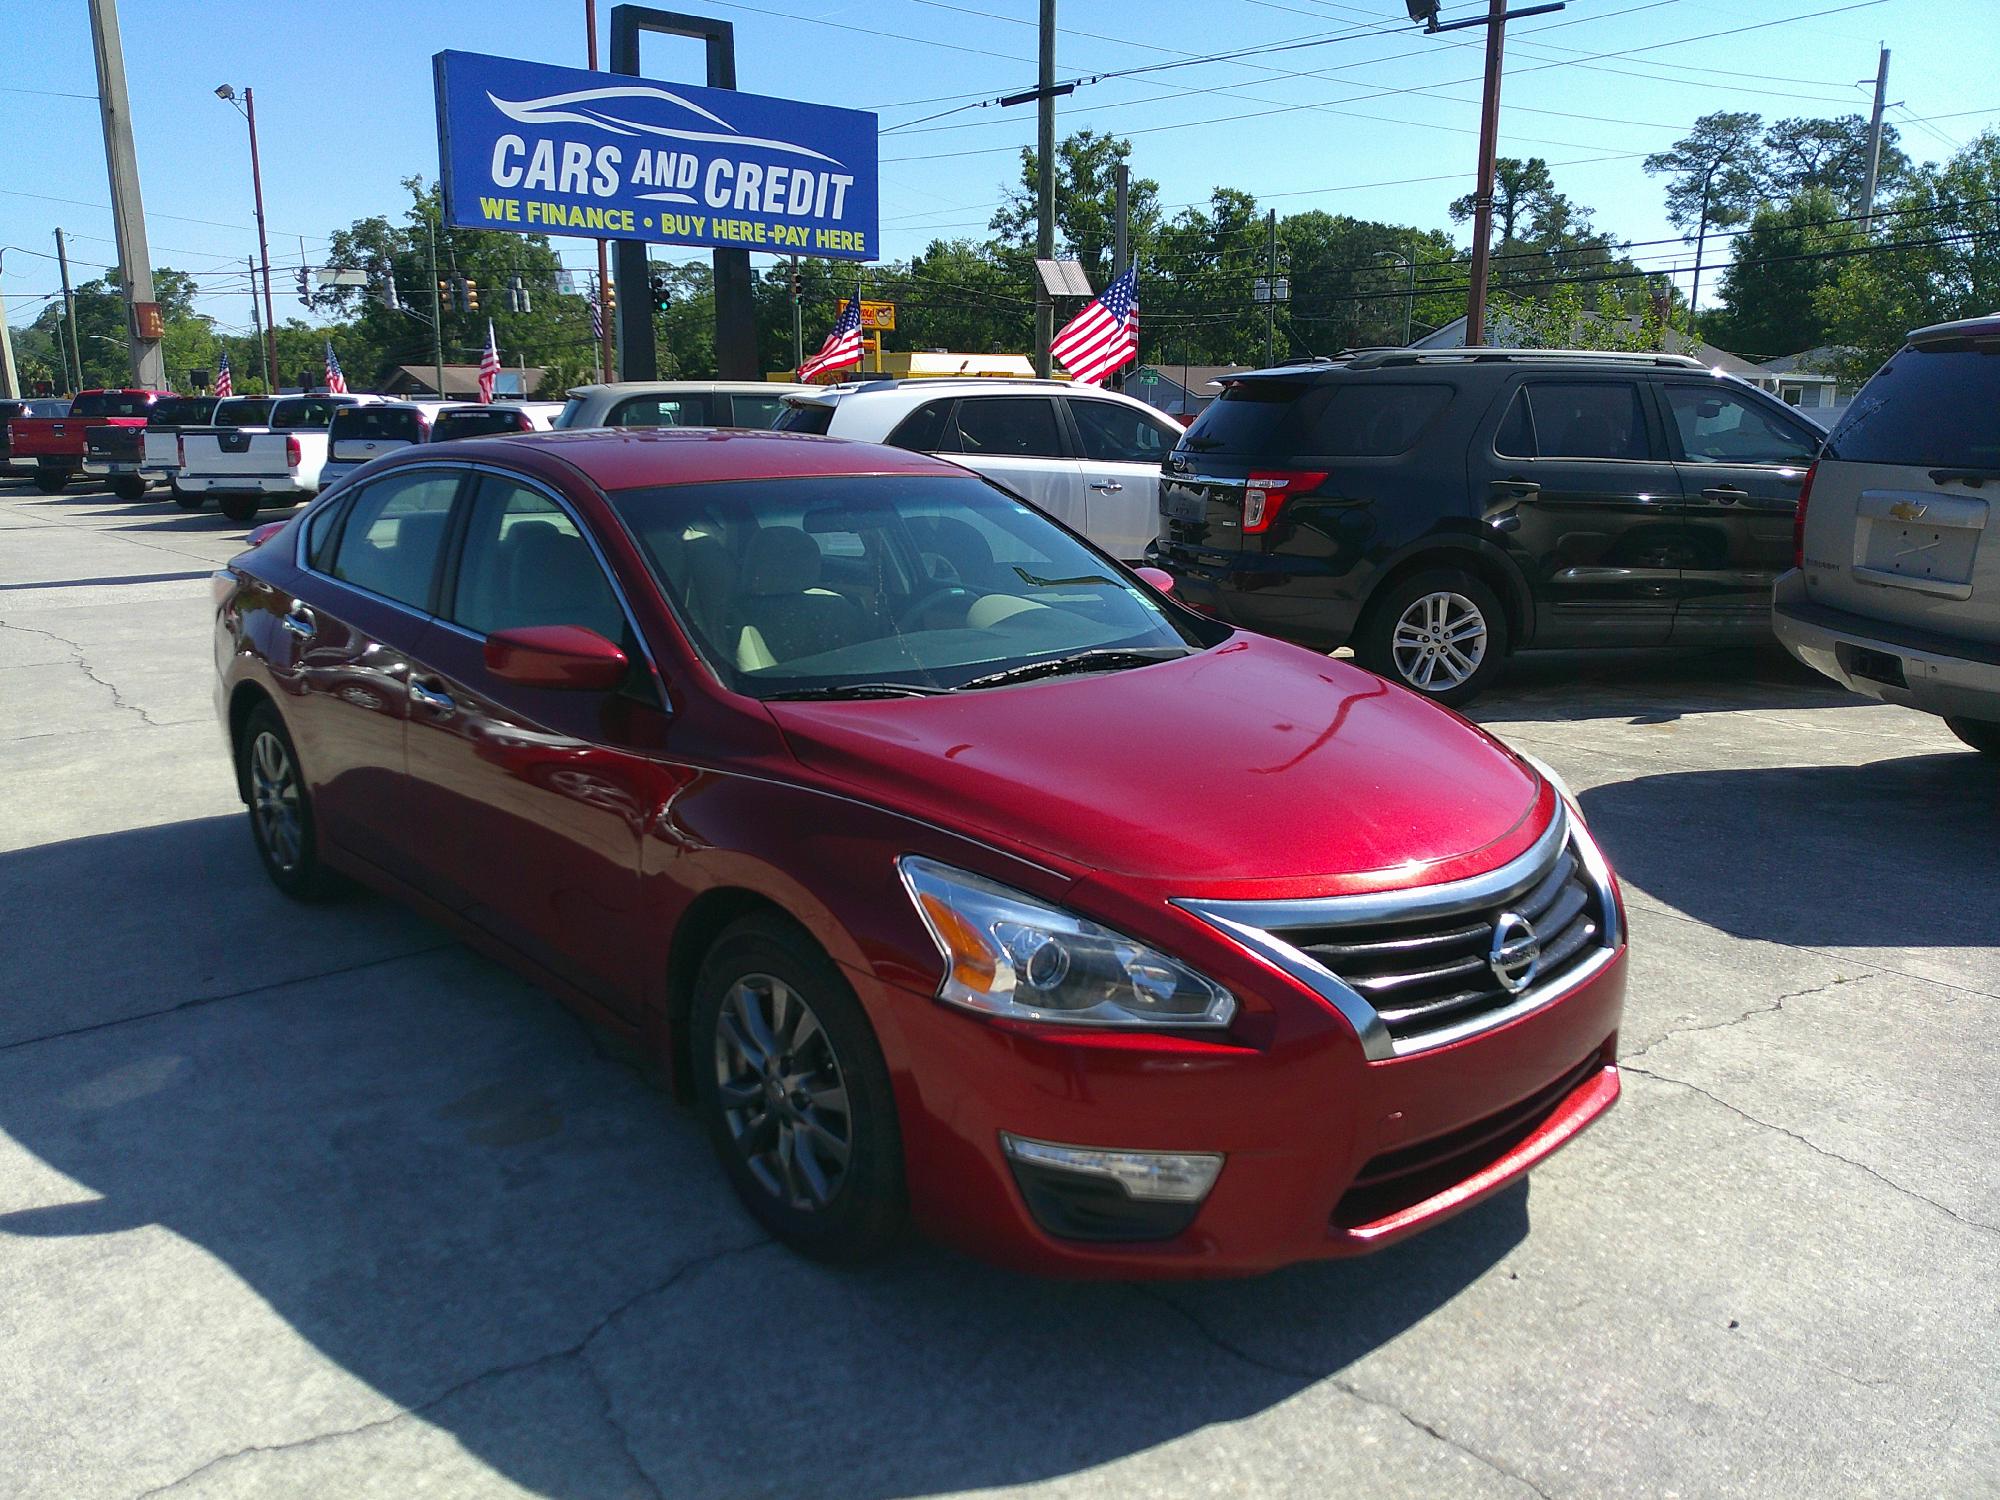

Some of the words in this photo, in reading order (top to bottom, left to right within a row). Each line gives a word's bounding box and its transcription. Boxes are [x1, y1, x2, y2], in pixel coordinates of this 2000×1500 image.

[491, 134, 622, 197] CARS
[630, 149, 699, 189] AND
[704, 158, 854, 220] CREDIT
[480, 197, 519, 222] WE
[527, 202, 635, 232] FINANCE
[661, 213, 706, 237] BUY
[815, 228, 865, 252] HERE
